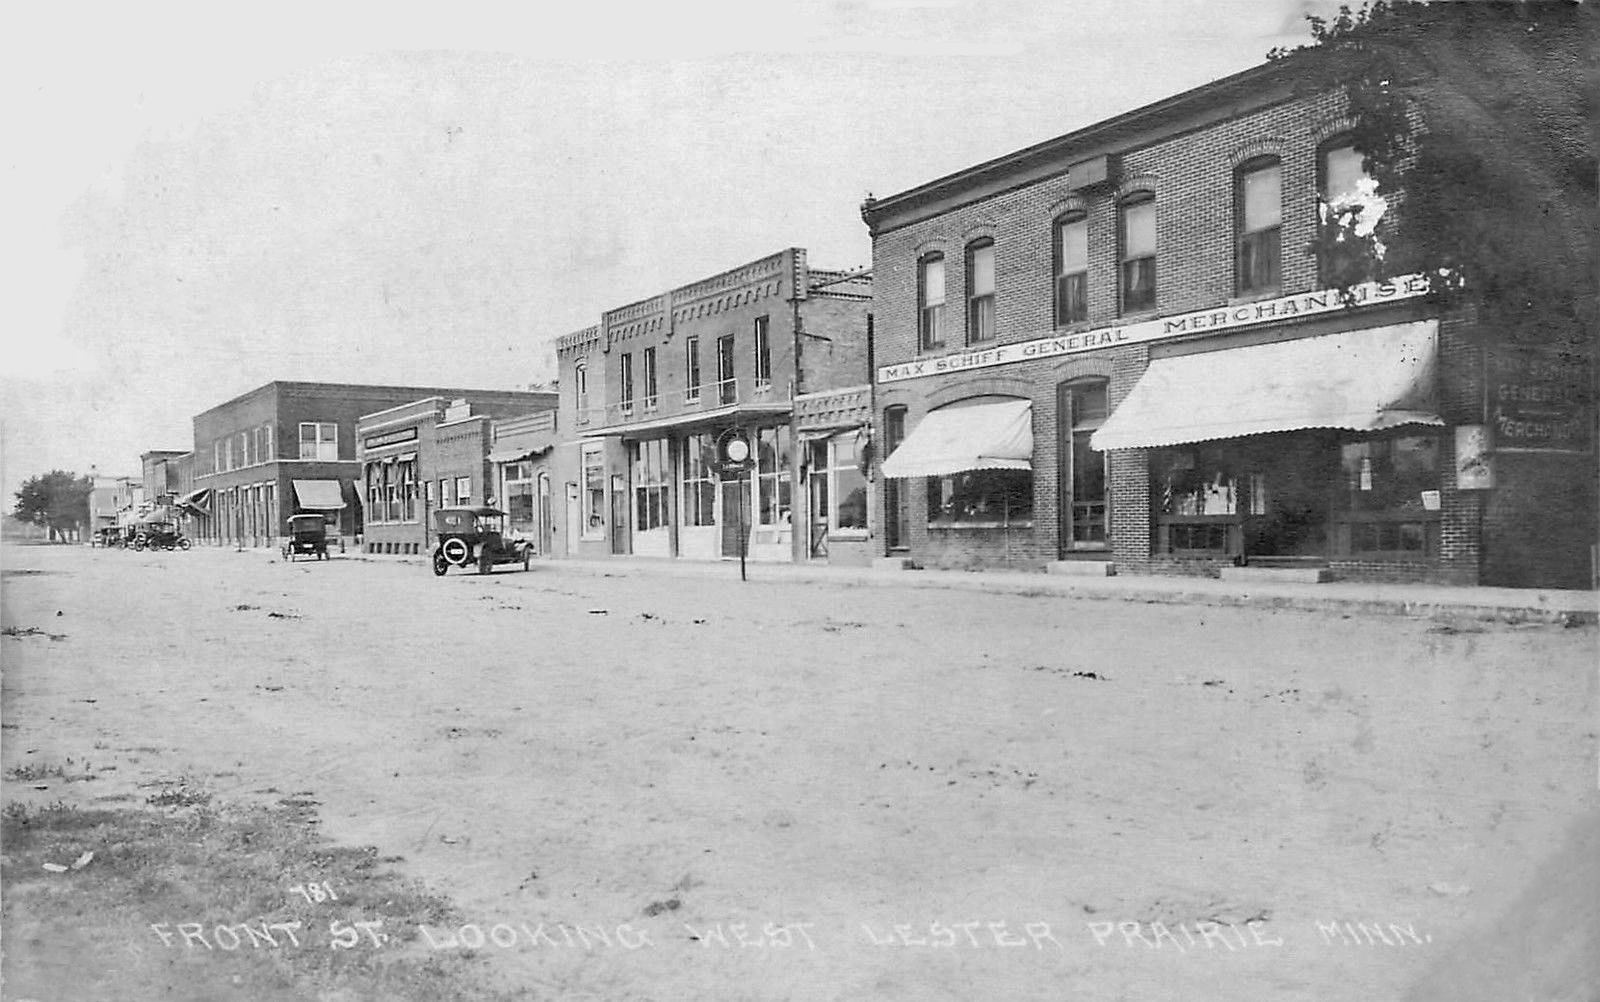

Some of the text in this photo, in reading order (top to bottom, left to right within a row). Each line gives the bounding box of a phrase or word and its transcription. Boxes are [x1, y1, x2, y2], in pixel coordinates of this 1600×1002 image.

[886, 276, 1431, 380] MAX SCHIFF GENERAL MERCHANISE
